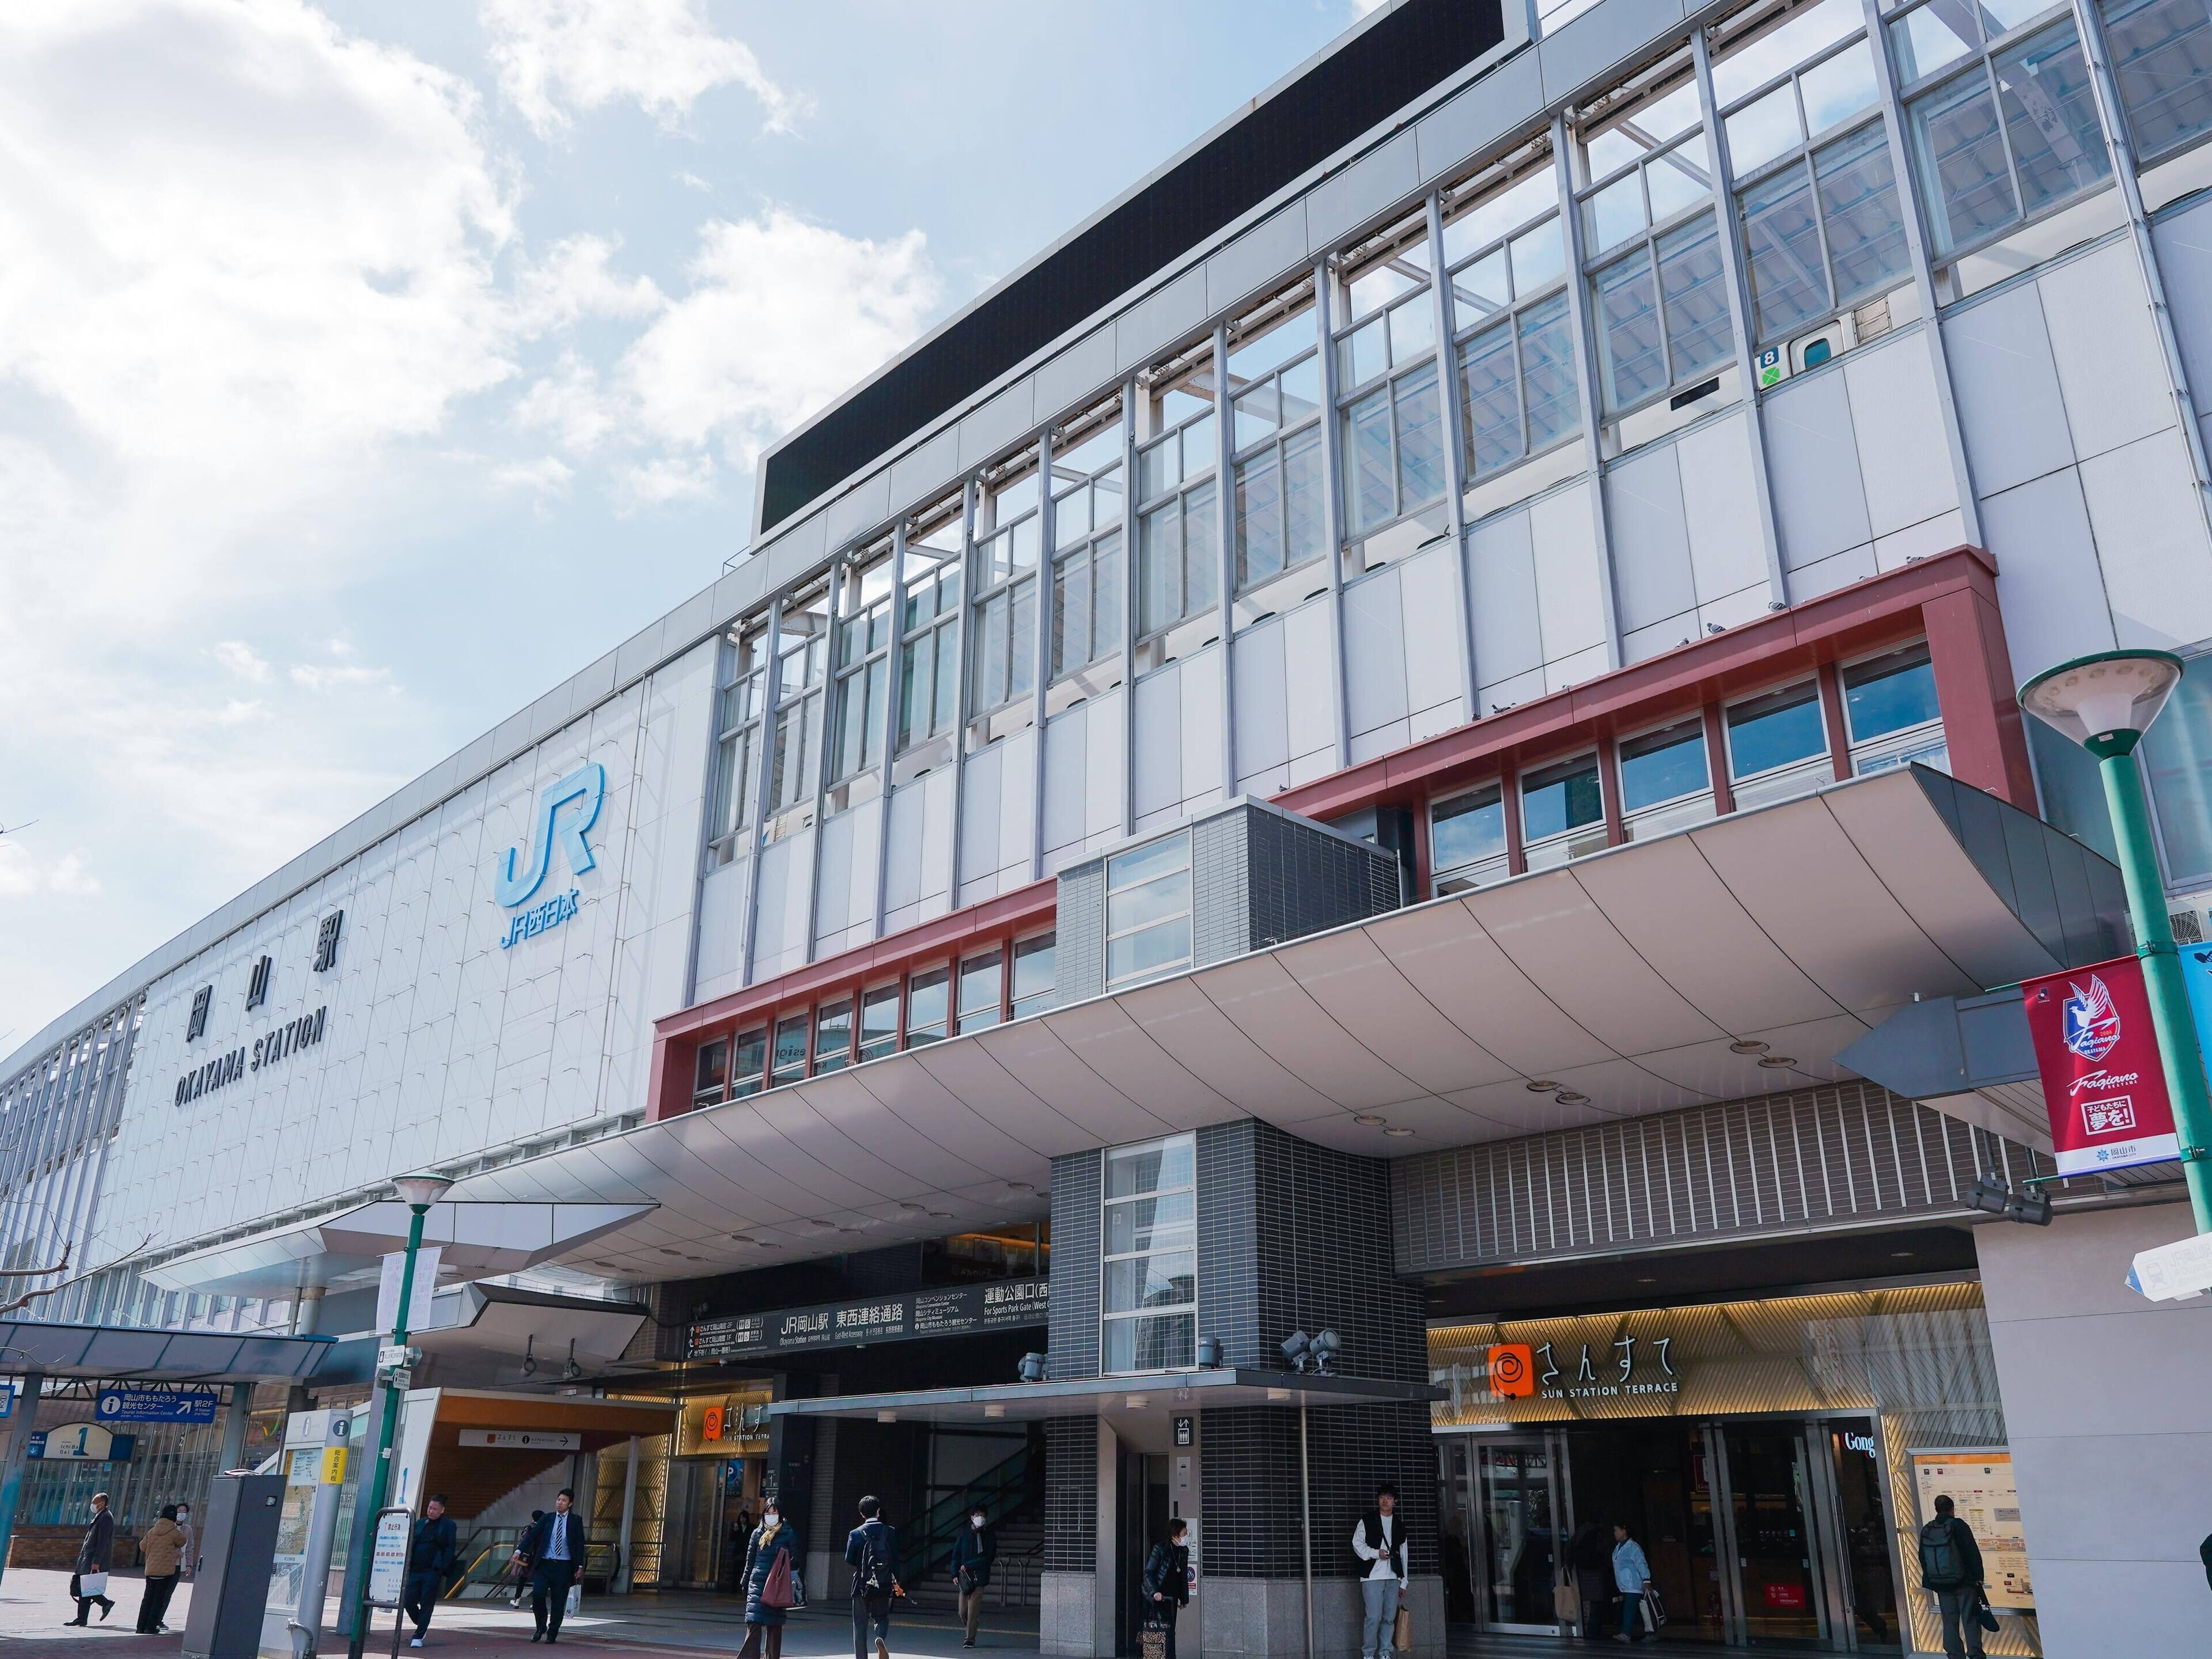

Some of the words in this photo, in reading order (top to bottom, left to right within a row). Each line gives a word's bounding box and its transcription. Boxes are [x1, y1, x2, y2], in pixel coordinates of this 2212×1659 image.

[1764, 351, 1775, 365] 8
[494, 762, 605, 907] JR
[499, 888, 580, 949] JR西日本
[186, 910, 344, 1043] 岡山駅
[2063, 1017, 2120, 1052] Fagiano
[175, 1046, 245, 1107] OKAYAMA
[250, 1006, 327, 1071] STATION
[2084, 1047, 2107, 1055] OKAYAMA
[2066, 1070, 2139, 1096] Fagiano
[2107, 1080, 2138, 1089] OKAYAMA
[2087, 1100, 2127, 1113] 子どもたちに
[2089, 1108, 2130, 1130] 夢を!
[2111, 1146, 2136, 1156] 岡山市
[916, 1293, 967, 1304] 岡山コンベンションセンター
[984, 1283, 1050, 1304] 運動公園口(西
[915, 1306, 959, 1317] 岡山シティミュージアム
[993, 1306, 1007, 1316] Sports
[1008, 1303, 1019, 1313] Park
[1020, 1303, 1032, 1311] Gate
[1032, 1301, 1047, 1310] (West
[781, 1313, 828, 1335] JR岡山駅
[836, 1303, 903, 1328] 東西連絡通路
[920, 1317, 977, 1330] 岡山市ももたろう観光センター
[780, 1337, 794, 1347] Okayama
[795, 1335, 806, 1344] Station
[835, 1331, 849, 1339] East-West
[1536, 1335, 1673, 1386] さんすて
[123, 1393, 176, 1402] 岡山市ももたろう
[1541, 1389, 1563, 1399] SUN
[1570, 1386, 1618, 1397] STATION
[1625, 1382, 1678, 1394] TERRACE
[122, 1402, 164, 1410] 観光センター
[1845, 1432, 1876, 1458] Gong
[331, 1449, 341, 1482] 総合案内板
